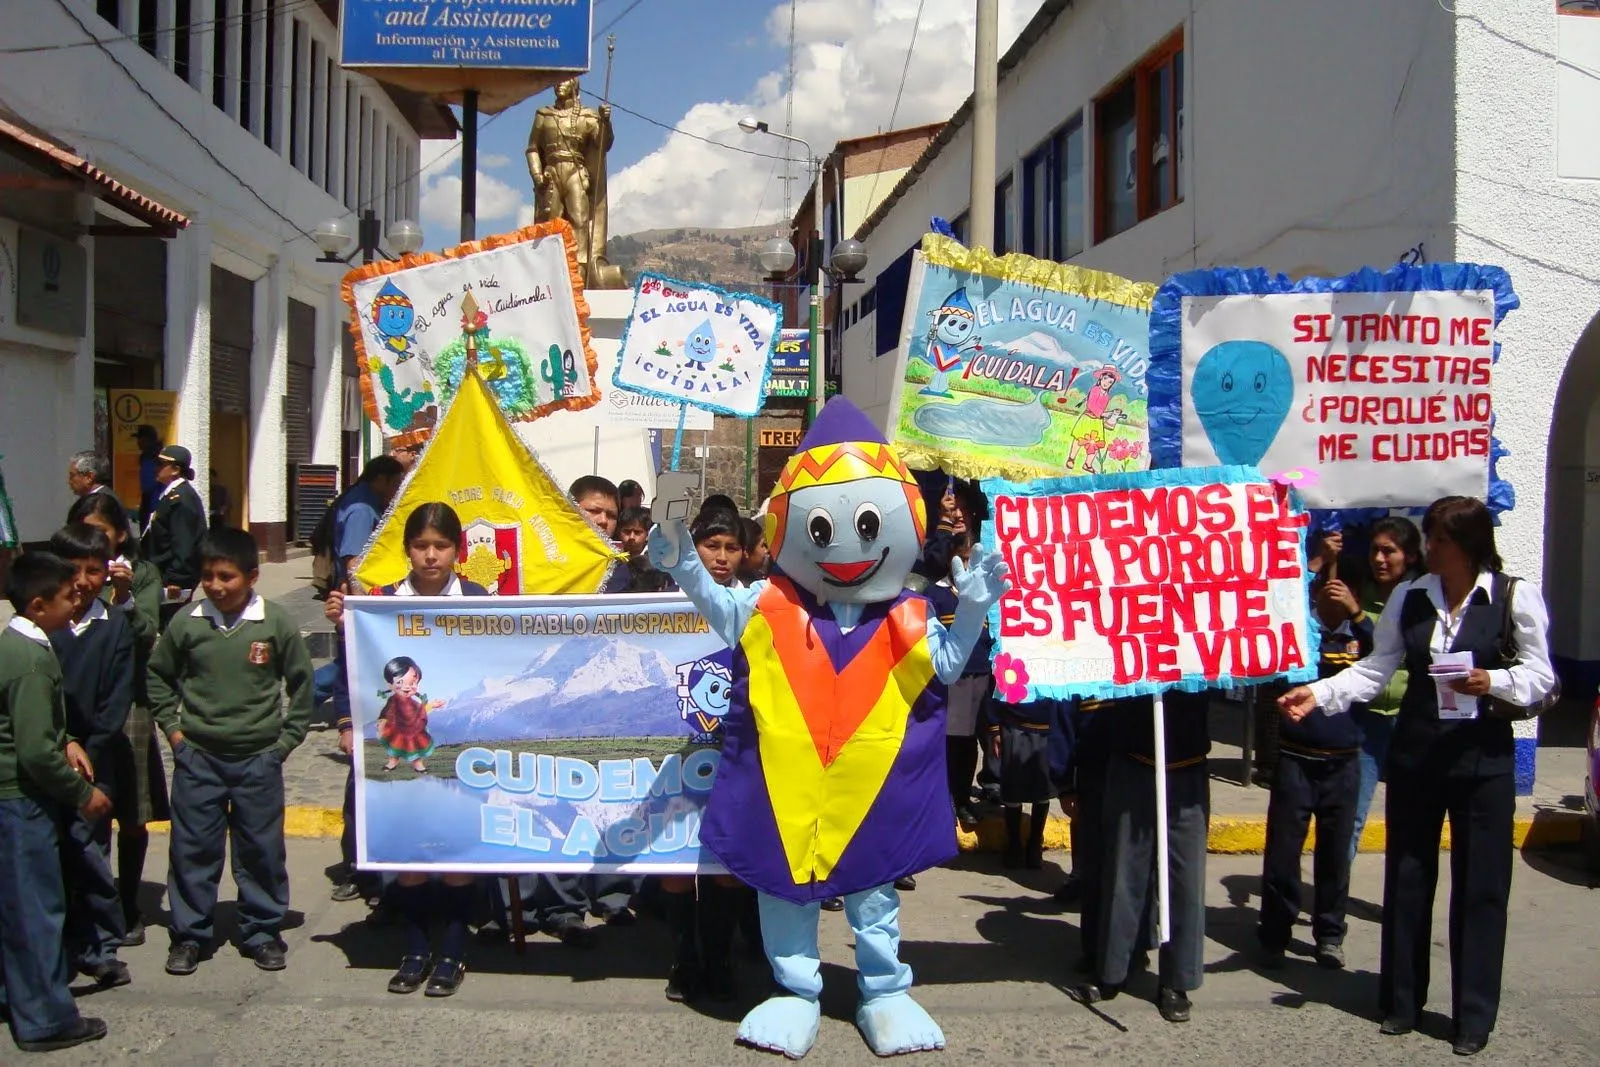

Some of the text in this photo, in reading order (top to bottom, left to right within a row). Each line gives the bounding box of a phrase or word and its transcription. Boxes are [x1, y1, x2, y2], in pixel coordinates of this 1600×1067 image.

[376, 33, 560, 49] Información y Asistencia
[385, 6, 552, 29] and Assistance
[432, 47, 501, 60] al Turista
[415, 316, 431, 332] El
[432, 293, 454, 317] agua
[480, 274, 500, 288] vida
[639, 301, 765, 350] EL AGUA ES VIDA
[975, 302, 1003, 327] EL
[1010, 298, 1077, 332] AGUA
[1085, 321, 1113, 347] ES
[1294, 315, 1492, 346] SI TANTO ME
[635, 353, 751, 393] ¡CUÍDALA!
[962, 349, 1080, 404] ¡CUÍDALA!
[1307, 355, 1490, 385] NECESITAS
[1302, 390, 1491, 425] ¿PORQUÉ NO
[1318, 434, 1358, 463] ME
[995, 483, 1311, 544] CUIDEMOS EL
[1104, 525, 1301, 586] PORQUE
[397, 614, 431, 636] I.E.
[520, 613, 588, 635] PABLO
[592, 612, 709, 634] ATUSPARIA
[1000, 580, 1270, 641] ES FUENTE
[1108, 622, 1305, 684] DE VIDA
[455, 747, 722, 801] CUIDEMO
[480, 803, 551, 852] EL
